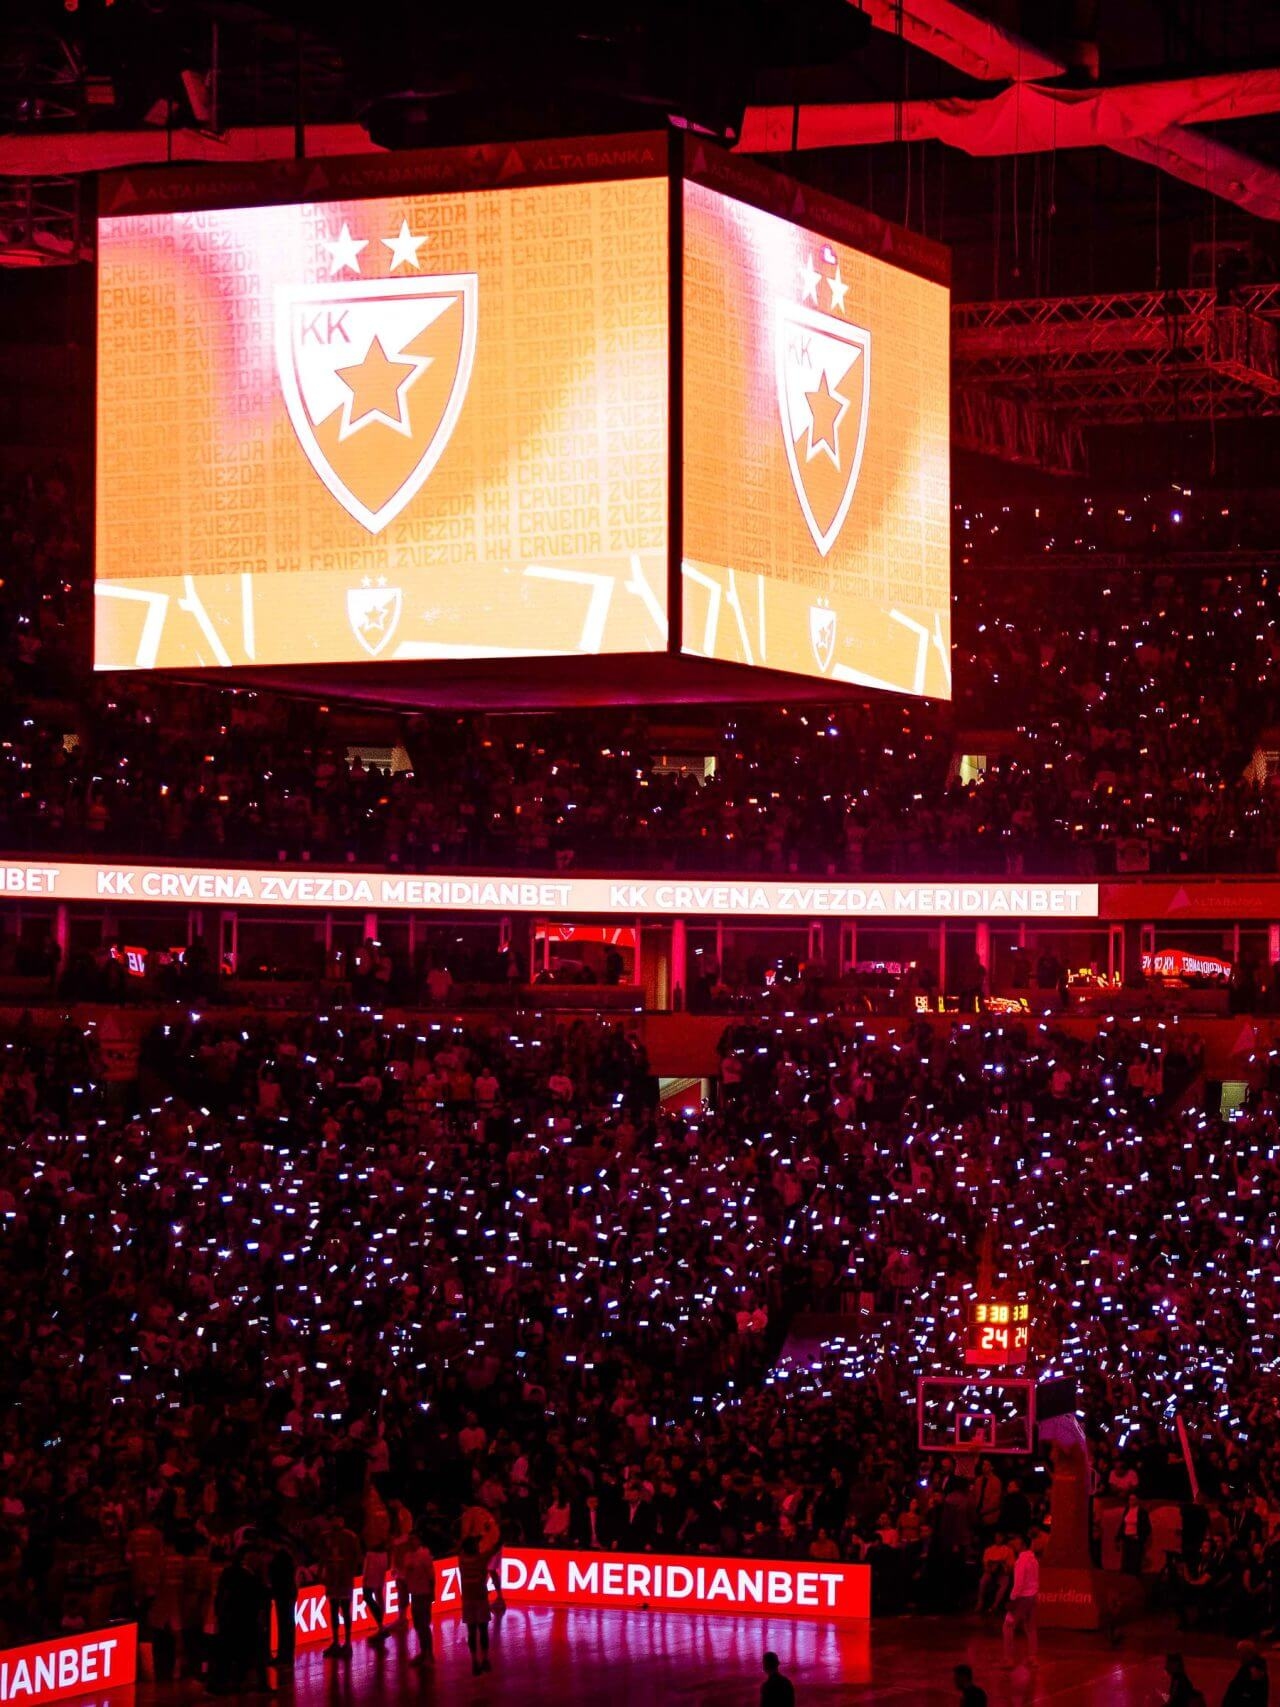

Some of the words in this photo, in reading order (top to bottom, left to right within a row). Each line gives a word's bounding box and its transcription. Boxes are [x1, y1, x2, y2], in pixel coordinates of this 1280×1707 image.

[534, 147, 655, 171] ALTABANKA
[301, 309, 351, 344] KK
[97, 871, 135, 895] KK
[142, 873, 254, 898] CRVENA
[260, 876, 374, 901] ZVEZDA
[381, 879, 572, 906] MERIDIANBET
[610, 885, 649, 908] KK
[655, 887, 770, 910] CRVENA
[777, 888, 887, 911] ZVEZDA
[894, 889, 1082, 912] MERIDIANBET
[981, 1327, 1008, 1350] 24
[1015, 1327, 1028, 1348] 24
[567, 1560, 844, 1607] MERIDIANBET
[0, 1639, 118, 1701] IANBET
